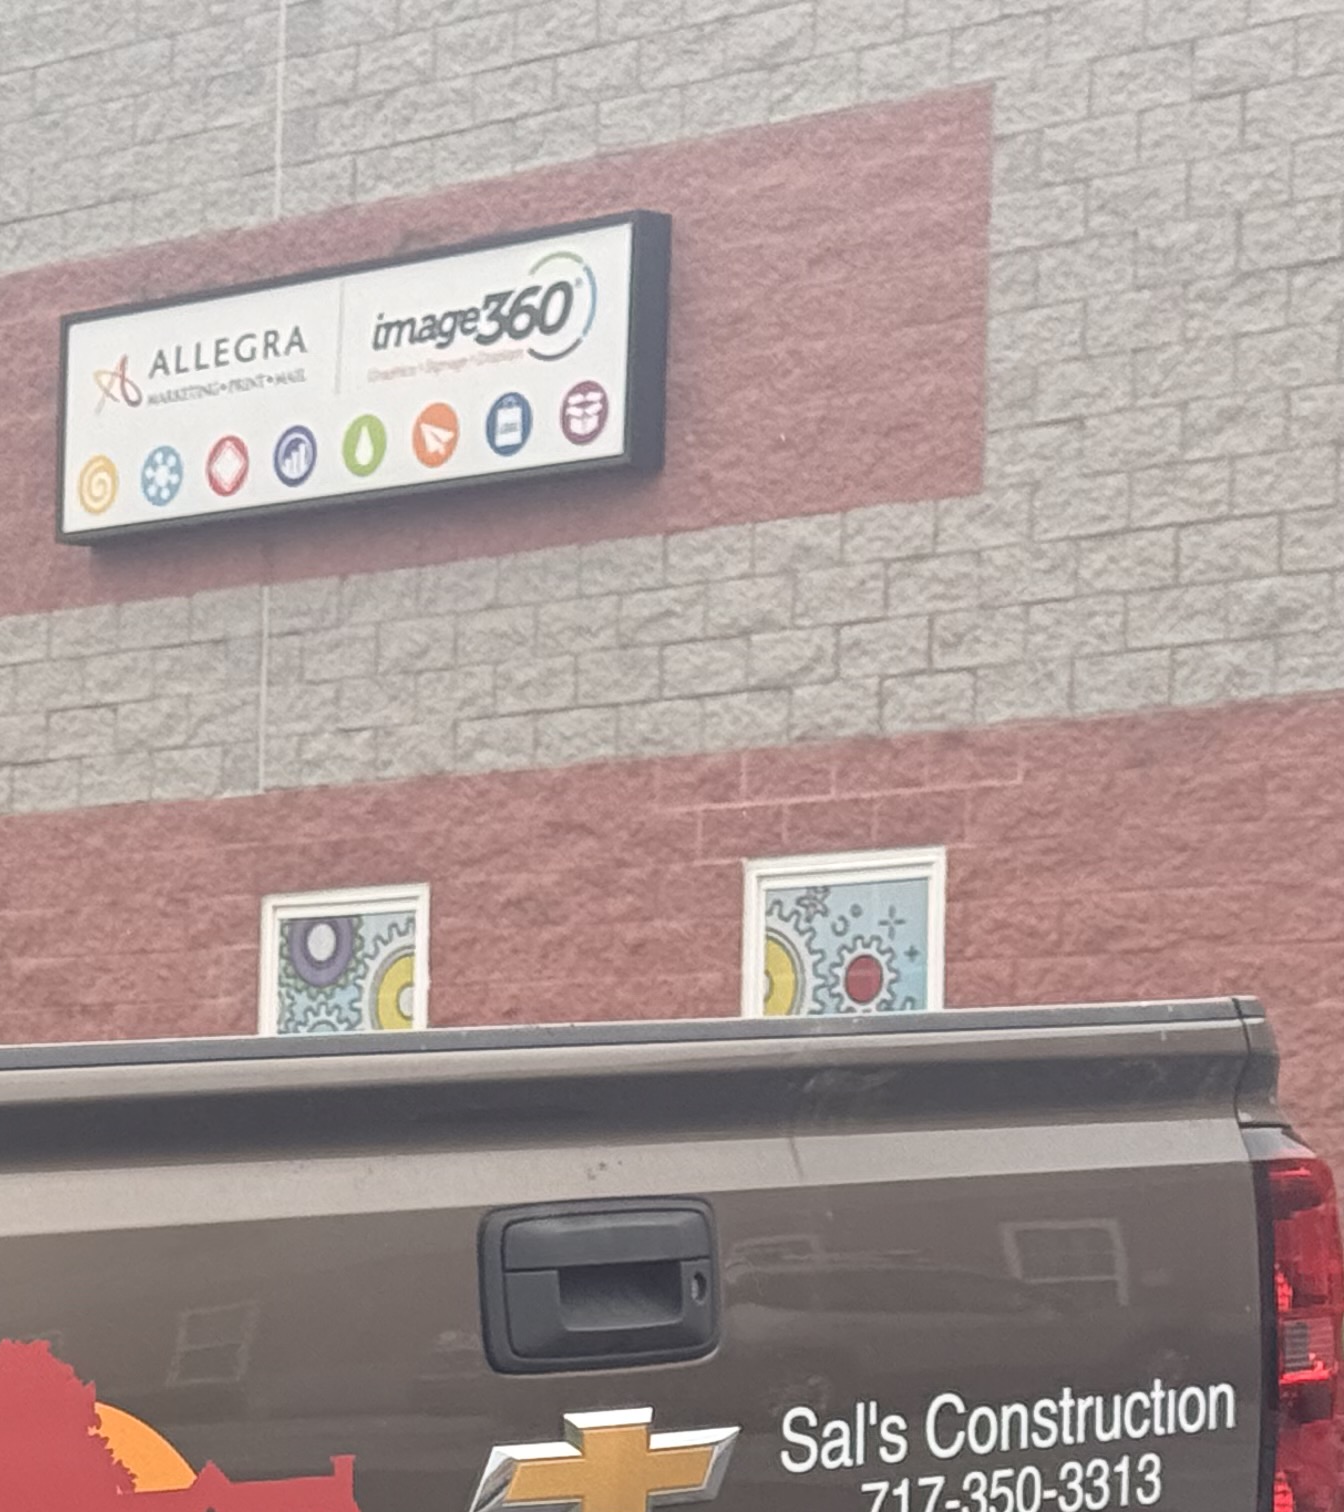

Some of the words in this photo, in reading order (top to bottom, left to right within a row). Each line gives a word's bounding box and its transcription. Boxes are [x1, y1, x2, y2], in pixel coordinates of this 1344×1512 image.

[148, 325, 308, 379] ALLEGRA
[780, 1400, 909, 1474] Sal's
[925, 1377, 1236, 1460] Construction
